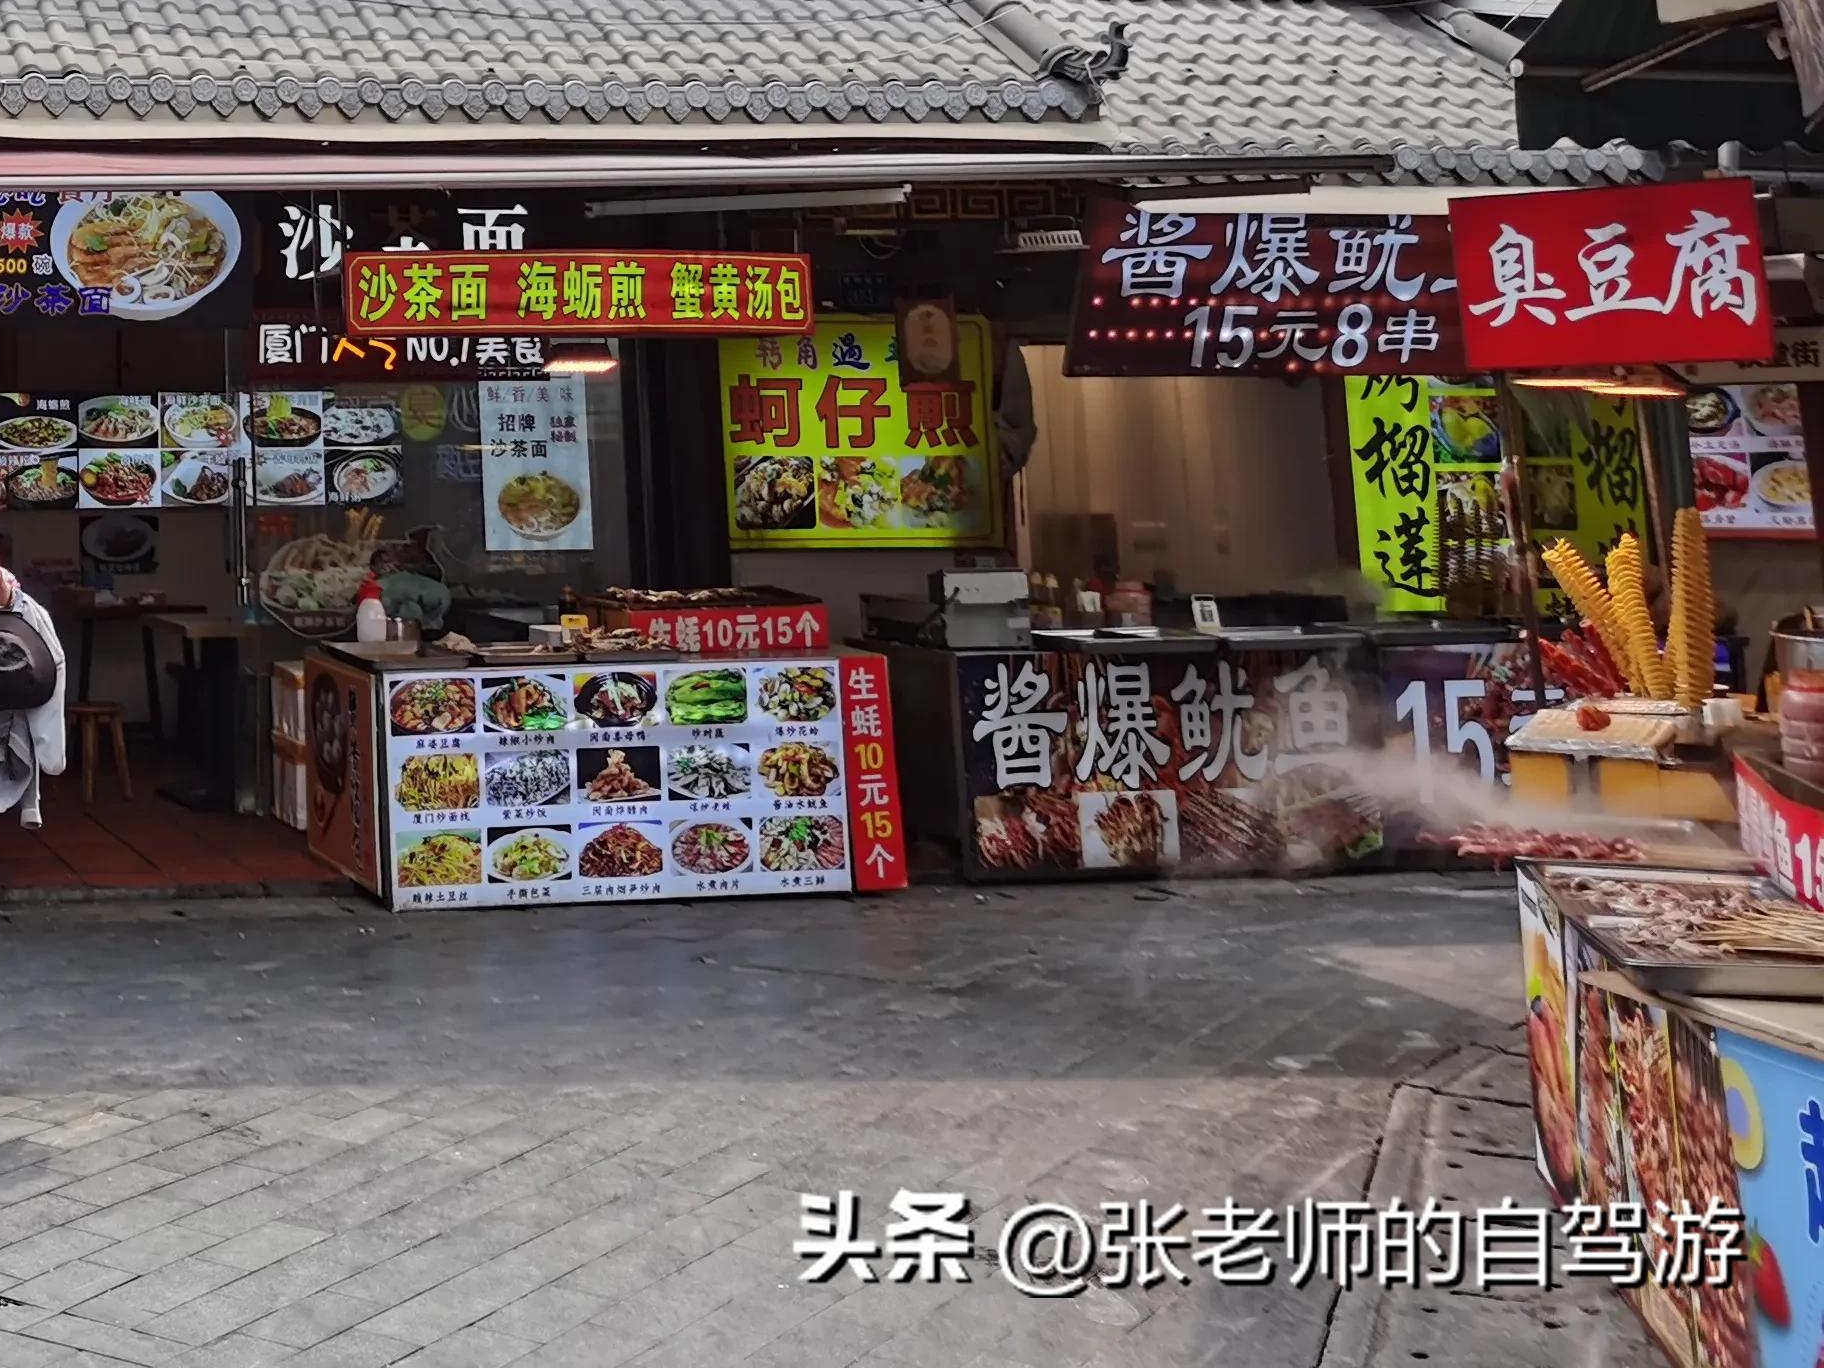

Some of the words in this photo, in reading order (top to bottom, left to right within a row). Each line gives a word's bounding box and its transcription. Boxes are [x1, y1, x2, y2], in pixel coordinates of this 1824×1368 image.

[1, 222, 34, 241] 爆款
[32, 253, 53, 275] 碗
[1101, 213, 1457, 302] 酱爆鱿
[1468, 209, 1760, 327] 臭豆腐
[358, 262, 489, 322] 沙茶面
[516, 260, 648, 321] 海蛎煎
[670, 261, 805, 322] 蟹黄汤包
[1183, 303, 1439, 369] 15元8串
[497, 413, 536, 432] 招牌
[729, 374, 979, 449] 蚵仔煎
[490, 439, 548, 458] 沙茶面
[416, 737, 461, 750] 麻婆豆腐
[973, 655, 1366, 790] 酱爆鱿鱼
[847, 666, 895, 879] 生蚝10元15个
[503, 808, 547, 821] 紫菜炒饭
[696, 878, 740, 891] 水煮肉片
